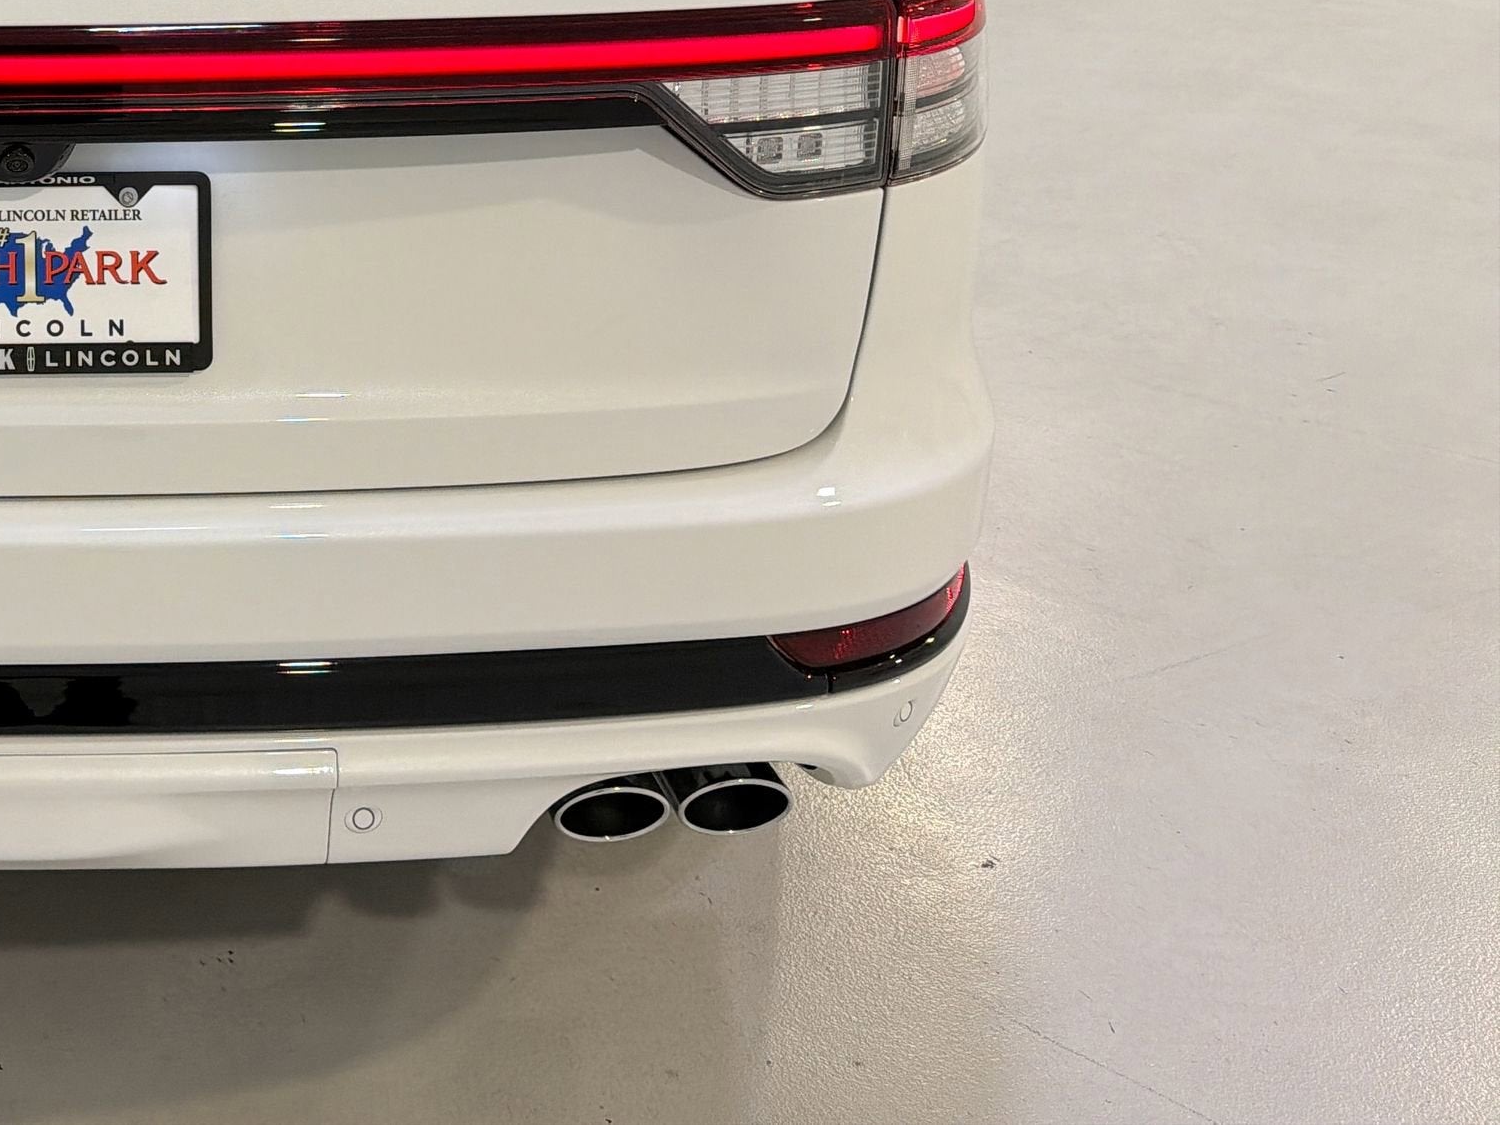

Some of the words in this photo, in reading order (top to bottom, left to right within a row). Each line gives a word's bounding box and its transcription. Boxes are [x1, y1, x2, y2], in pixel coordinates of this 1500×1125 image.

[69, 208, 143, 222] RETAILER
[43, 249, 168, 286] PARK
[45, 349, 182, 367] LINCOLN
